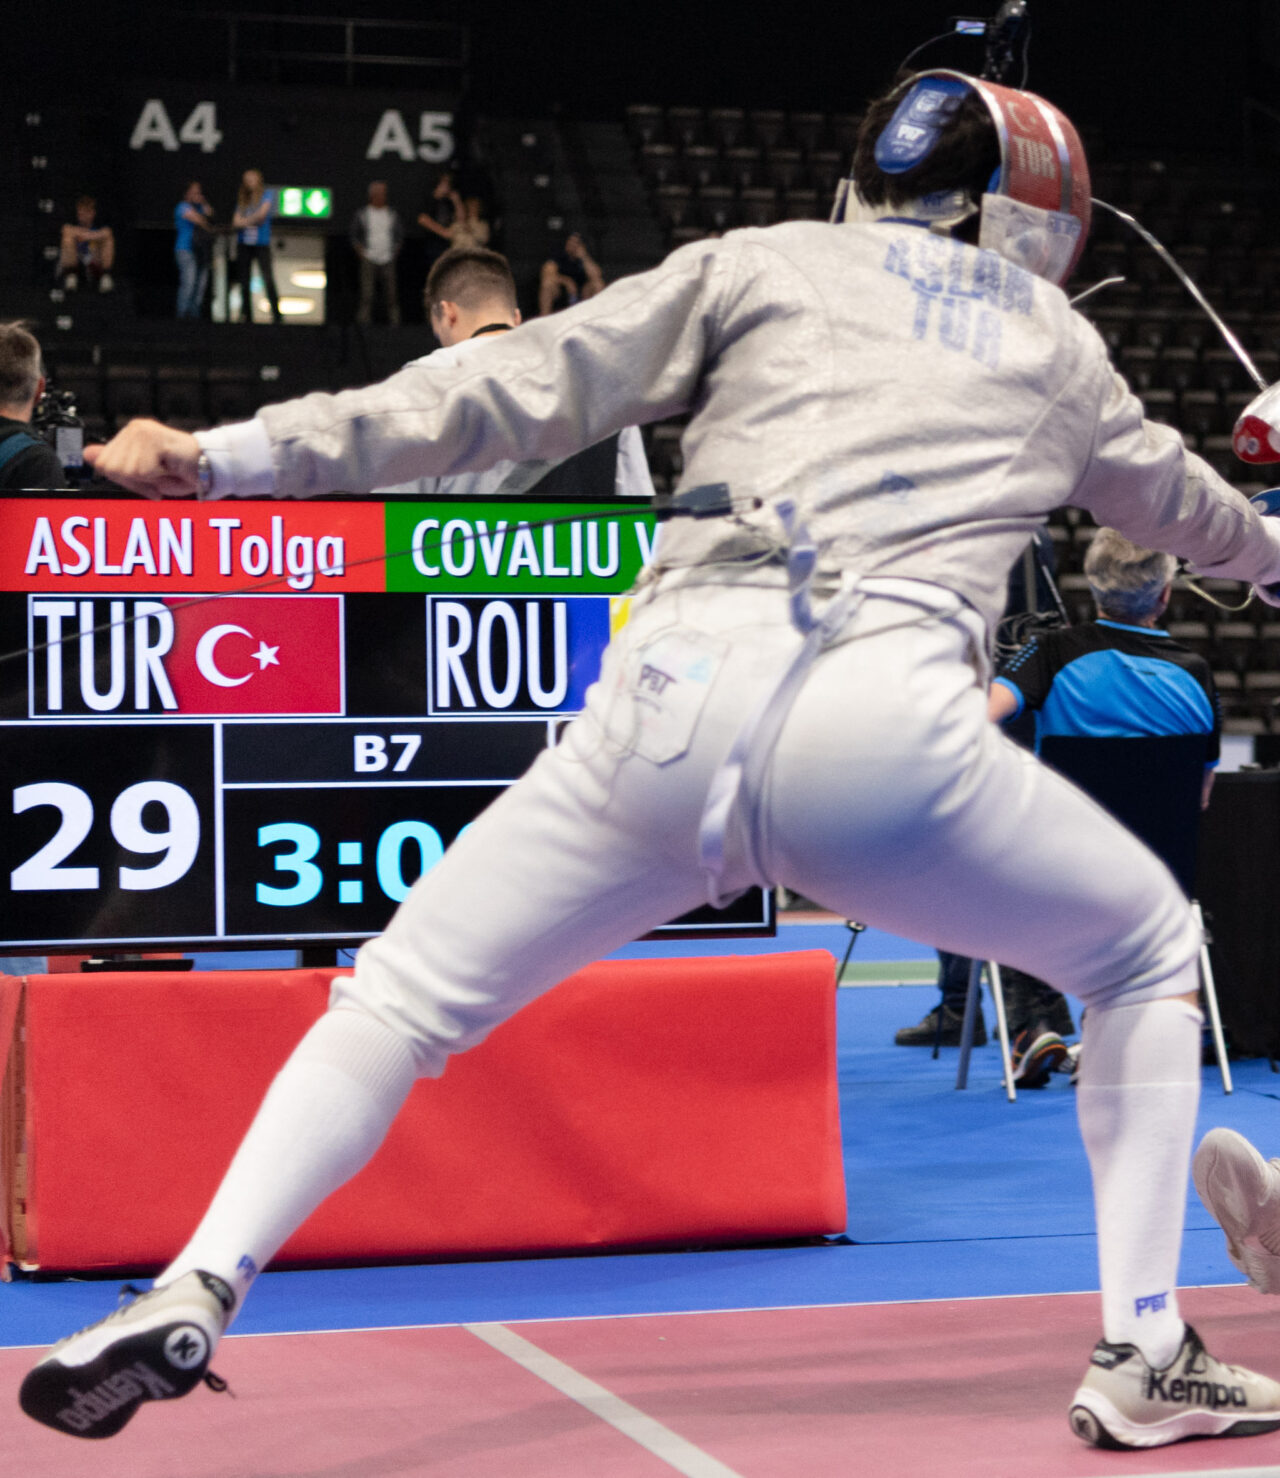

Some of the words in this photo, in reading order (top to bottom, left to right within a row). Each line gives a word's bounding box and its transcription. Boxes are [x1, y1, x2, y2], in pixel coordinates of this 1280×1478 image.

[129, 99, 222, 151] A4
[366, 109, 455, 163] A5
[1011, 134, 1057, 180] TUR
[911, 284, 1002, 370] TUR
[24, 515, 194, 576] ASLAN
[208, 515, 345, 590] Tolga
[411, 518, 620, 578] COVALIU
[33, 600, 179, 712] TUR
[435, 600, 568, 709] ROU
[353, 734, 422, 773] B7
[10, 780, 201, 891] 29
[255, 820, 475, 907] 3:0
[1135, 1291, 1168, 1317] PBT
[56, 1361, 176, 1431] Kempa
[1147, 1373, 1248, 1410] Kempa
